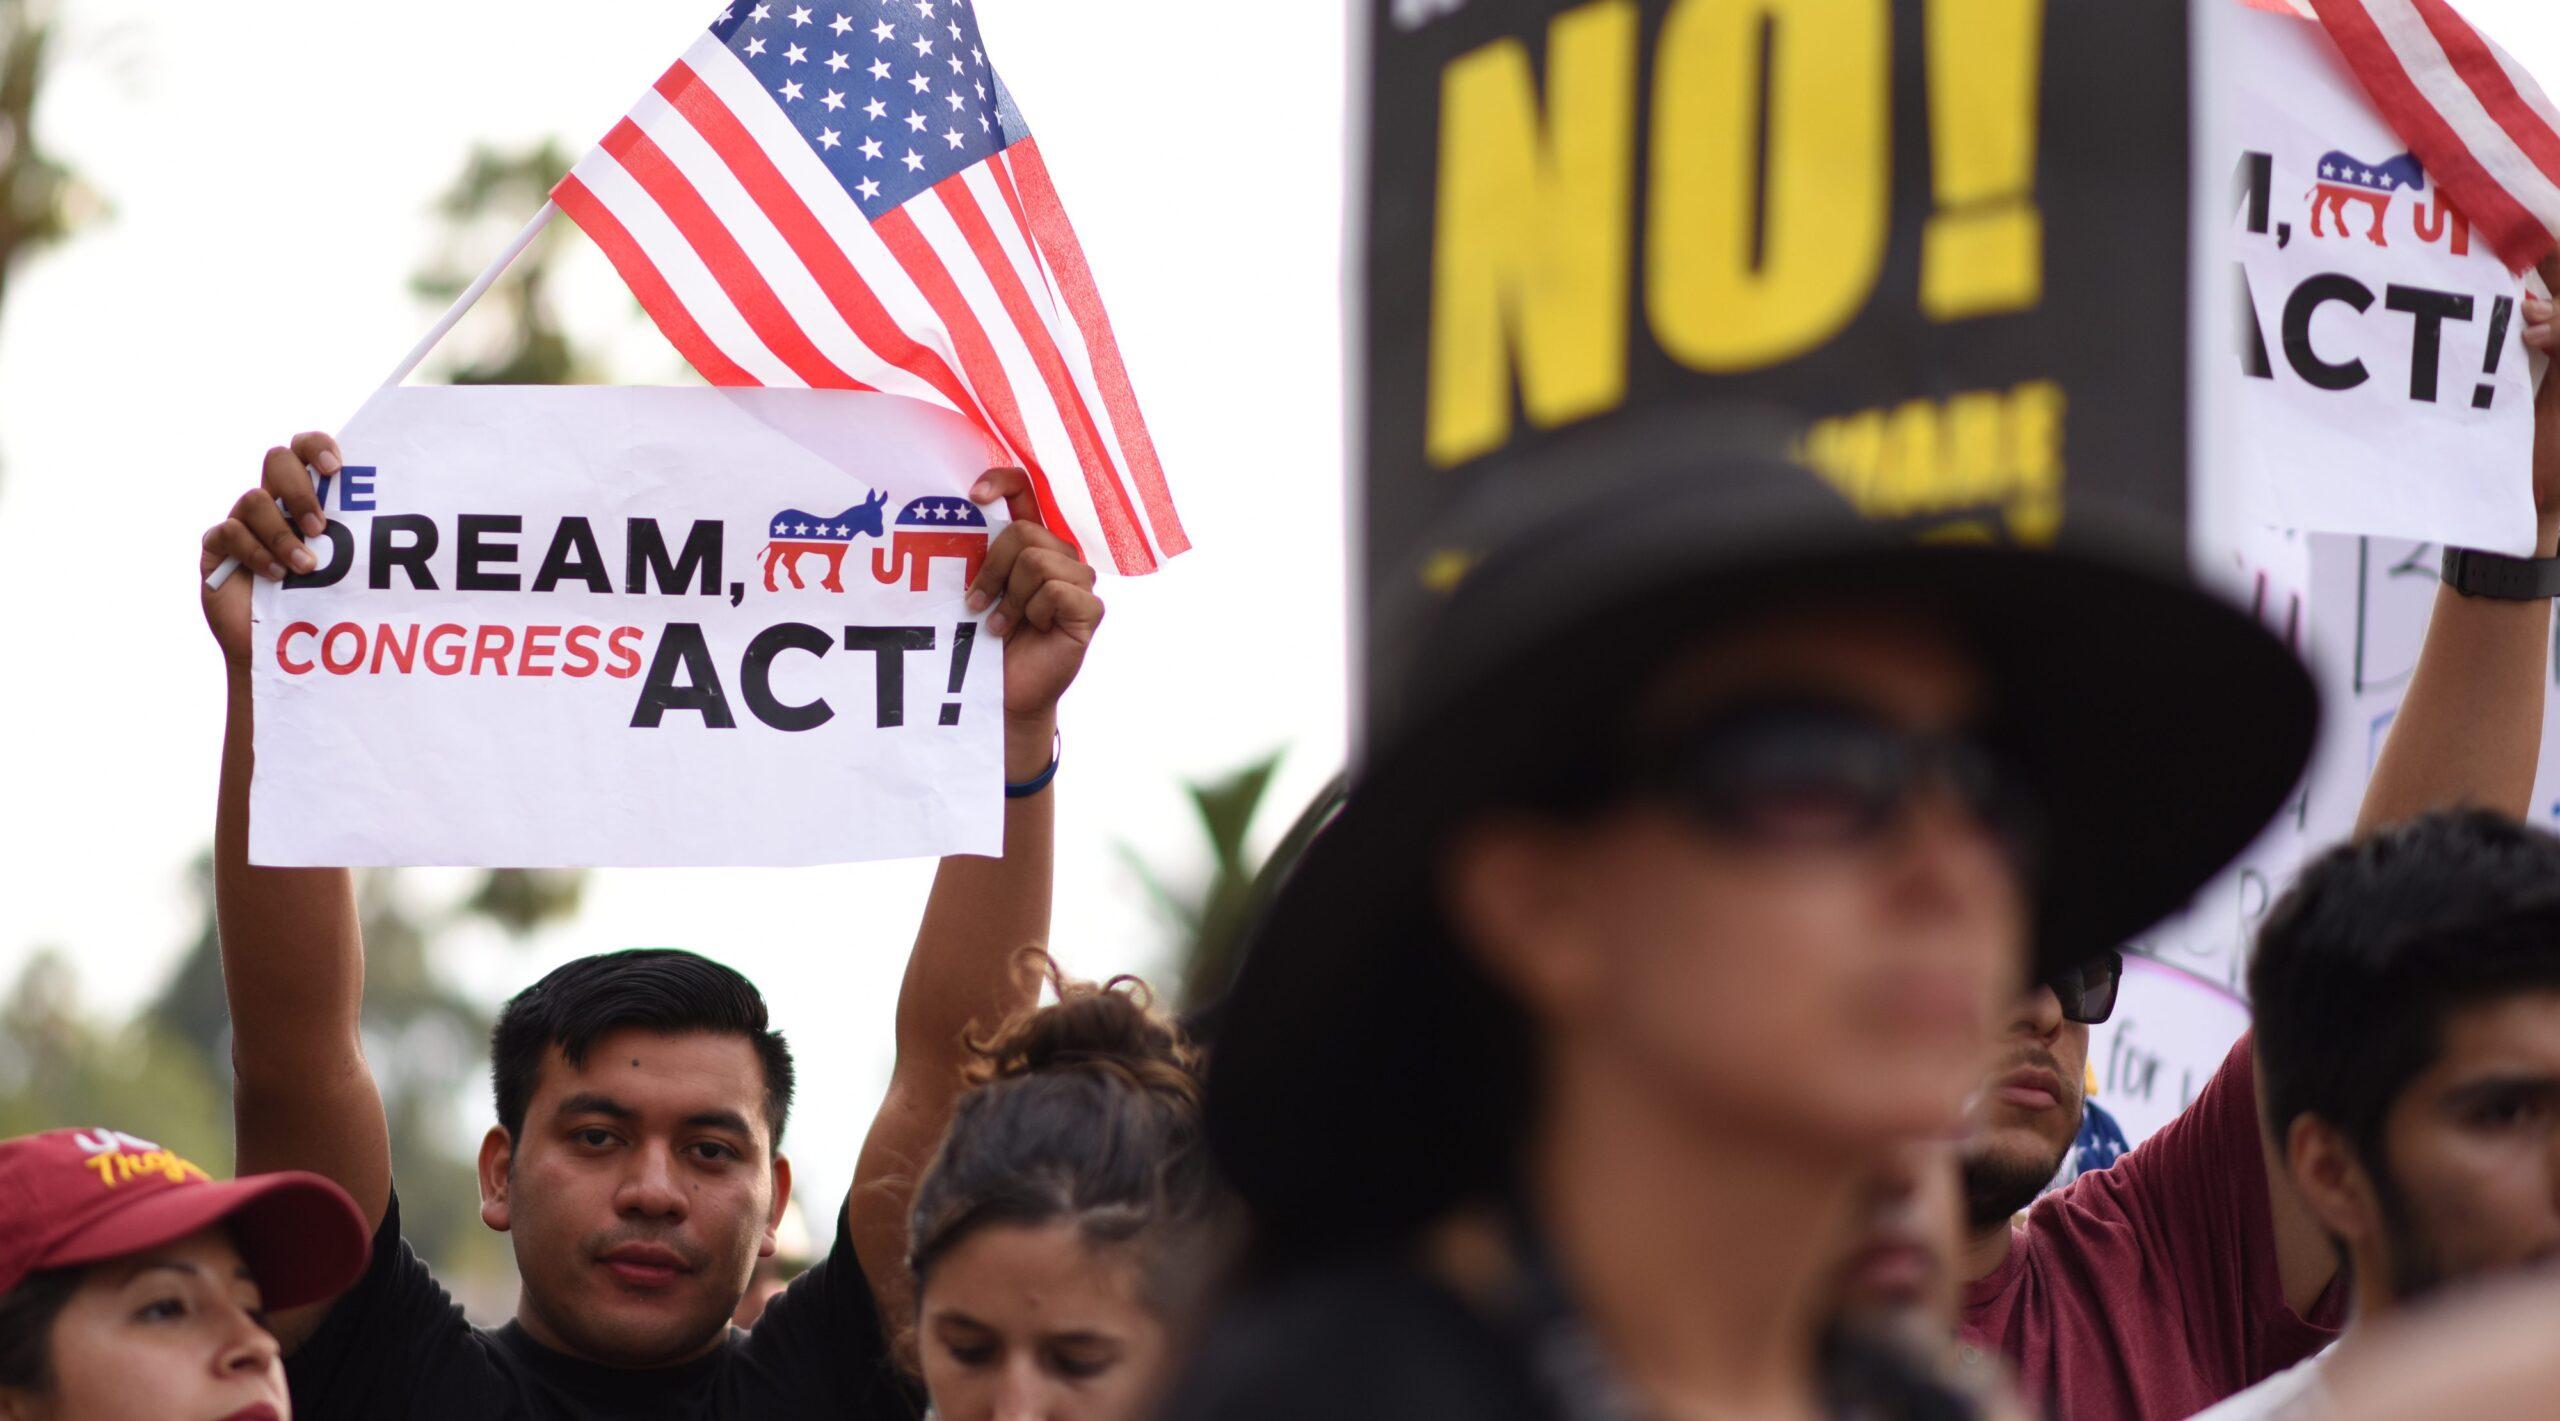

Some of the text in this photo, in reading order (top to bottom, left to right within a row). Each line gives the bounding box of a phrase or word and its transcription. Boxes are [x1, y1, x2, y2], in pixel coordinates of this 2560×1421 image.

[1422, 0, 2046, 470] NO!
[279, 514, 746, 607] DREAM,
[276, 622, 644, 679] CONGRESS
[628, 621, 977, 733] ACT!
